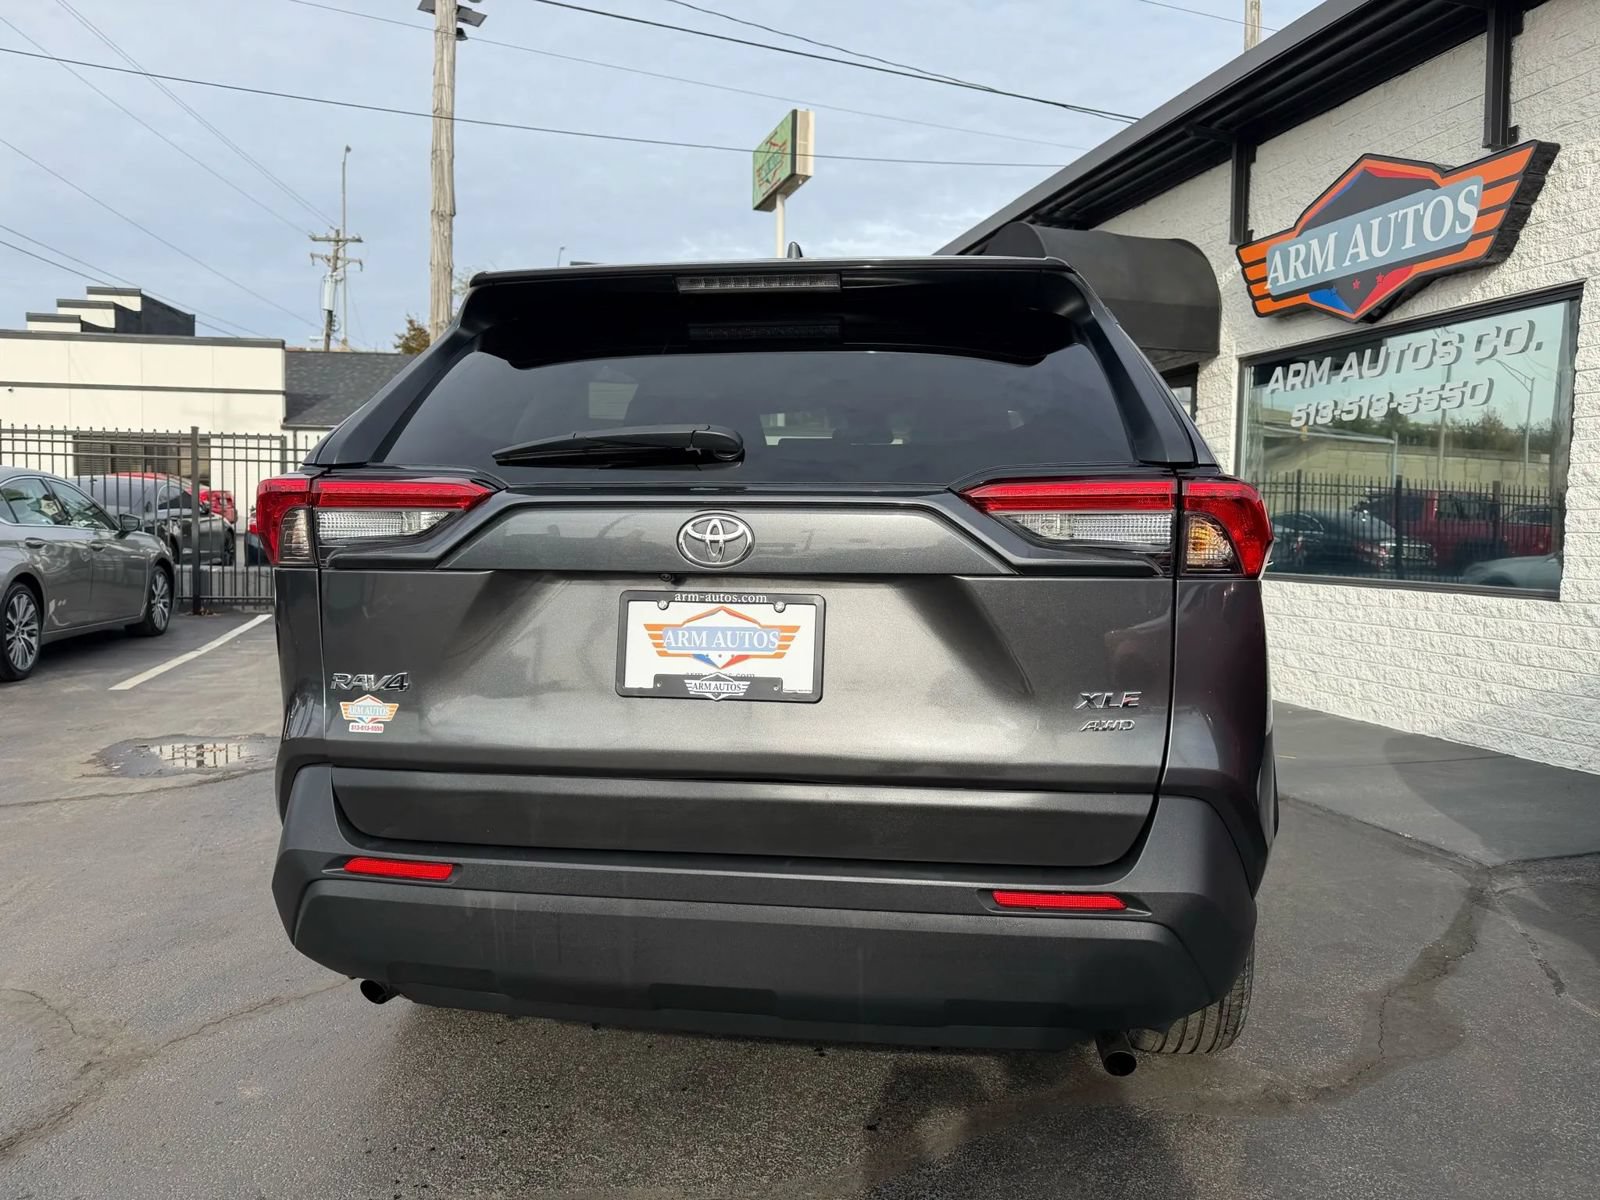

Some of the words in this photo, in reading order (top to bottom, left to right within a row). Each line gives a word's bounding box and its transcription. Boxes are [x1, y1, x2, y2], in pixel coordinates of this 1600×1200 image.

[1265, 232, 1337, 290] ARM
[1343, 184, 1479, 266] AUTOS
[1266, 356, 1332, 393] ARM
[1333, 333, 1464, 382] AUTOS
[1474, 319, 1543, 365] CO.
[674, 592, 768, 603] arm-autos.com
[663, 628, 707, 648] ARM
[712, 630, 780, 650] AUTOS
[330, 672, 409, 692] RAV4
[692, 682, 711, 691] ARM
[713, 682, 741, 691] AUTOS
[1074, 691, 1142, 709] XLE
[1080, 719, 1136, 732] AWD
